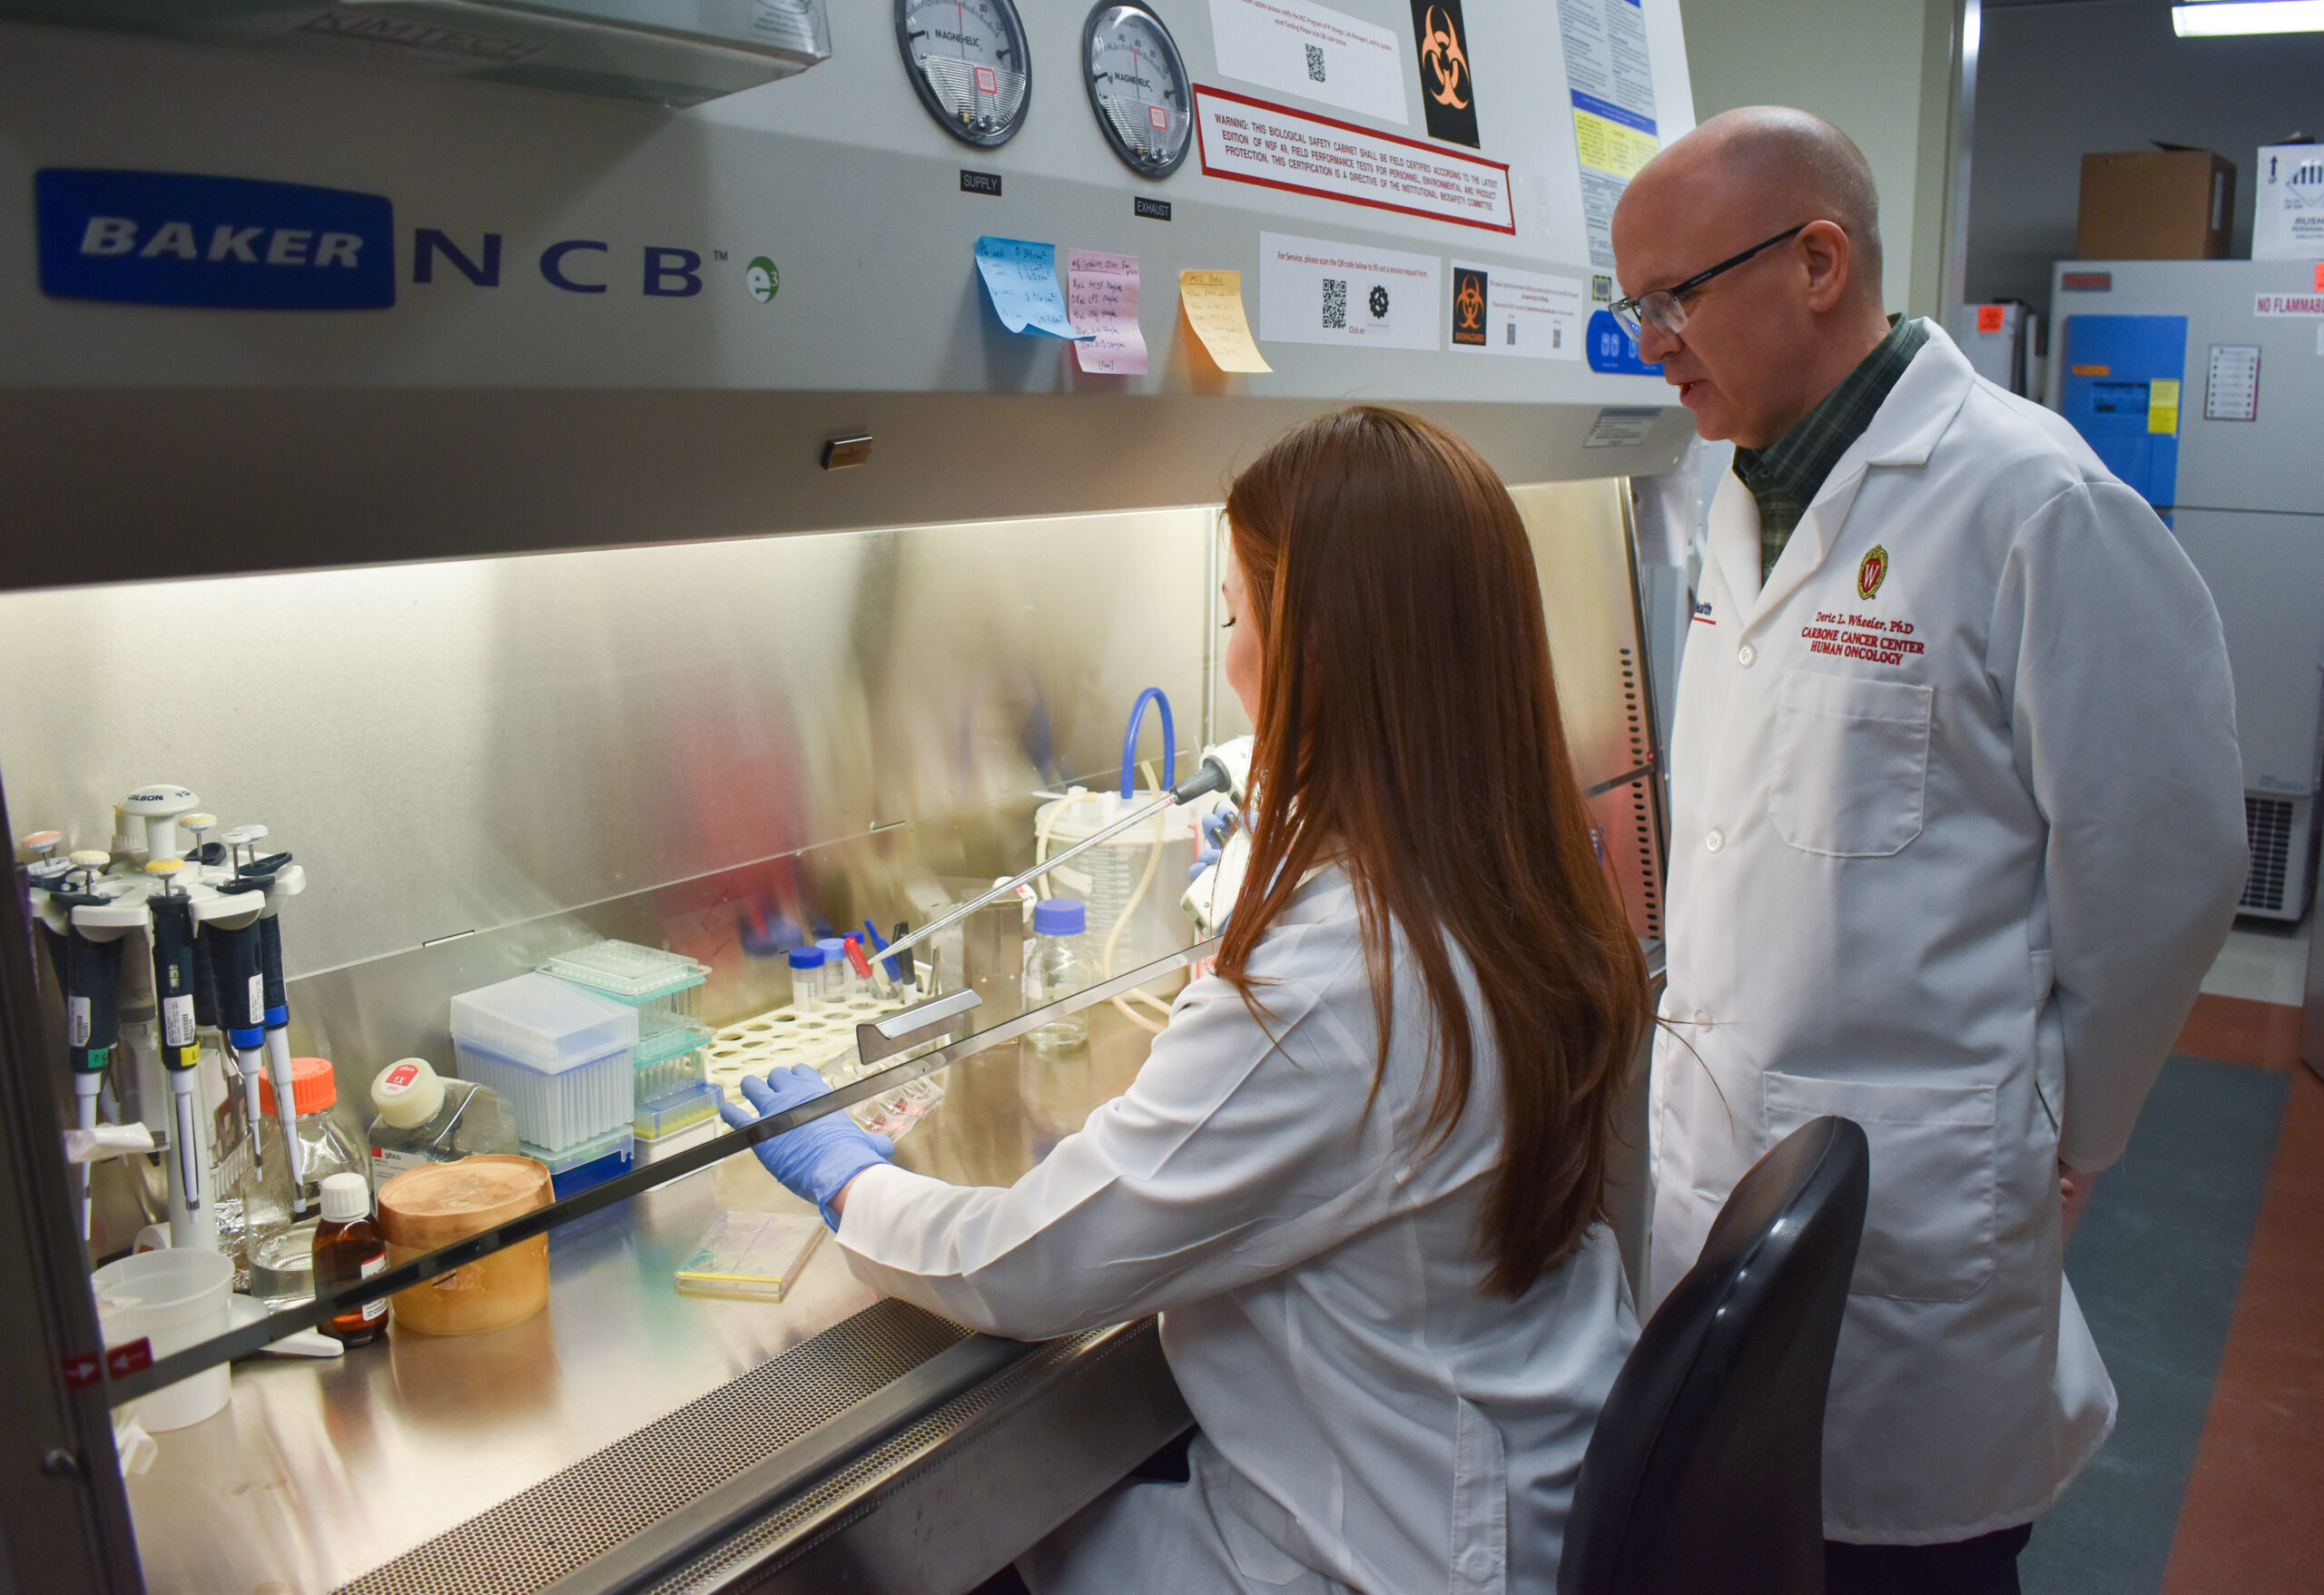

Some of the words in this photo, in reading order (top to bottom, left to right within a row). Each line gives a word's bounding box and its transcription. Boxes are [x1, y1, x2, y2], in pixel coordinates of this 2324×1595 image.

[935, 29, 980, 47] MAGNEHELIC
[1115, 73, 1150, 88] MAGNEHELIC
[1215, 113, 1249, 131] WARNING:
[1252, 123, 1266, 135] THIS
[1269, 126, 1305, 143] BIOLOGICAL
[1309, 136, 1331, 150] SAFETY
[1334, 143, 1357, 156] CABINET
[1360, 149, 1377, 160] SHALL
[1380, 153, 1387, 162] BE
[1390, 156, 1403, 166] FIELD
[1406, 160, 1431, 173] CERTIFIED
[1434, 167, 1461, 180] ACCORDING
[1462, 173, 1470, 182] TO
[1471, 175, 1480, 184] THE
[1482, 178, 1498, 188] LATEST
[1222, 131, 1248, 144] EDITION
[1254, 138, 1262, 147] OF
[1265, 140, 1277, 151] NSF
[1280, 143, 1288, 155] 49,
[1292, 146, 1308, 158] FIELD
[1312, 151, 1354, 169] PERFORMANCE
[1356, 162, 1374, 172] TESTS
[1376, 166, 1387, 176] FOR
[1423, 176, 1462, 192] ENVIRONMENTAL
[1465, 186, 1473, 195] AND
[1476, 189, 1496, 200] PRODUCT
[964, 174, 998, 191] SUPPLY
[1226, 145, 1268, 162] PROTECTION.
[1271, 154, 1285, 166] THIS
[1289, 159, 1333, 176] CERTIFICATION
[1334, 168, 1340, 178] IS
[1350, 172, 1377, 187] DIRECTIVE
[1380, 179, 1387, 188] OF
[1390, 182, 1400, 192] THE
[1403, 183, 1438, 199] INSTITUTIONAL
[1441, 192, 1465, 205] BIOSAFETY
[1137, 201, 1169, 217] EXHAUST
[80, 215, 363, 268] BAKER
[1286, 254, 1303, 262] Service,
[1305, 257, 1318, 265] please
[1338, 260, 1344, 268] QR
[1355, 261, 1367, 270] below
[2258, 298, 2270, 312] NO
[1349, 326, 1358, 334] Click
[1866, 564, 1879, 589] W
[1816, 612, 1836, 623] Deric
[1837, 614, 1846, 625] L.
[1848, 615, 1886, 632] Wheeler,
[1802, 627, 1839, 642] CARBONE
[1841, 632, 1877, 648] CANCER
[1880, 637, 1925, 654] CENTER
[1811, 641, 1843, 655] HUMAN
[1845, 645, 1903, 665] ONCOLOGY
[392, 1076, 407, 1085] 1X
[385, 1152, 401, 1160] gibco
